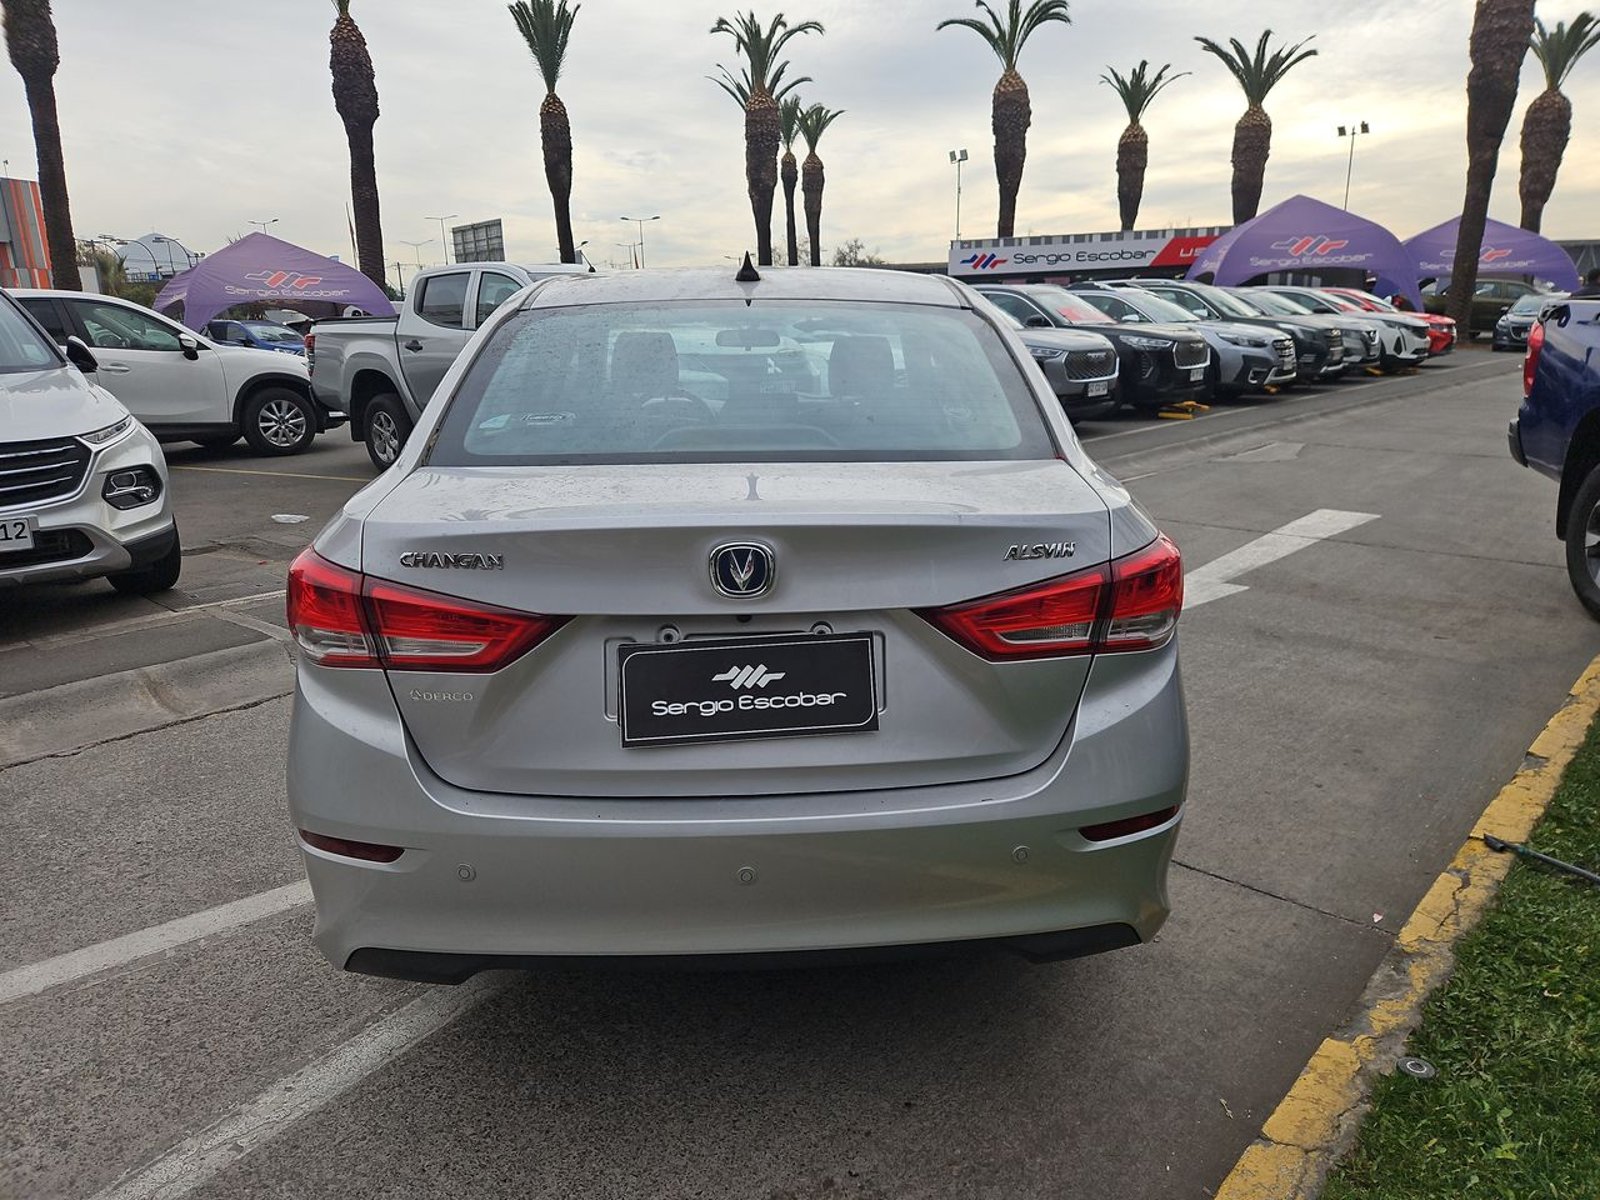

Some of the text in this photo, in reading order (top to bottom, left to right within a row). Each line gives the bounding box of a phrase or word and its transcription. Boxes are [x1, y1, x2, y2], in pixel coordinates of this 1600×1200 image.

[1013, 250, 1156, 266] Sergio Escobar
[0, 522, 28, 541] 12
[400, 551, 504, 570] CHANGAN
[1003, 542, 1076, 561] ALSVIN
[423, 692, 473, 701] DERCO
[651, 692, 847, 716] Sergio Escobar
